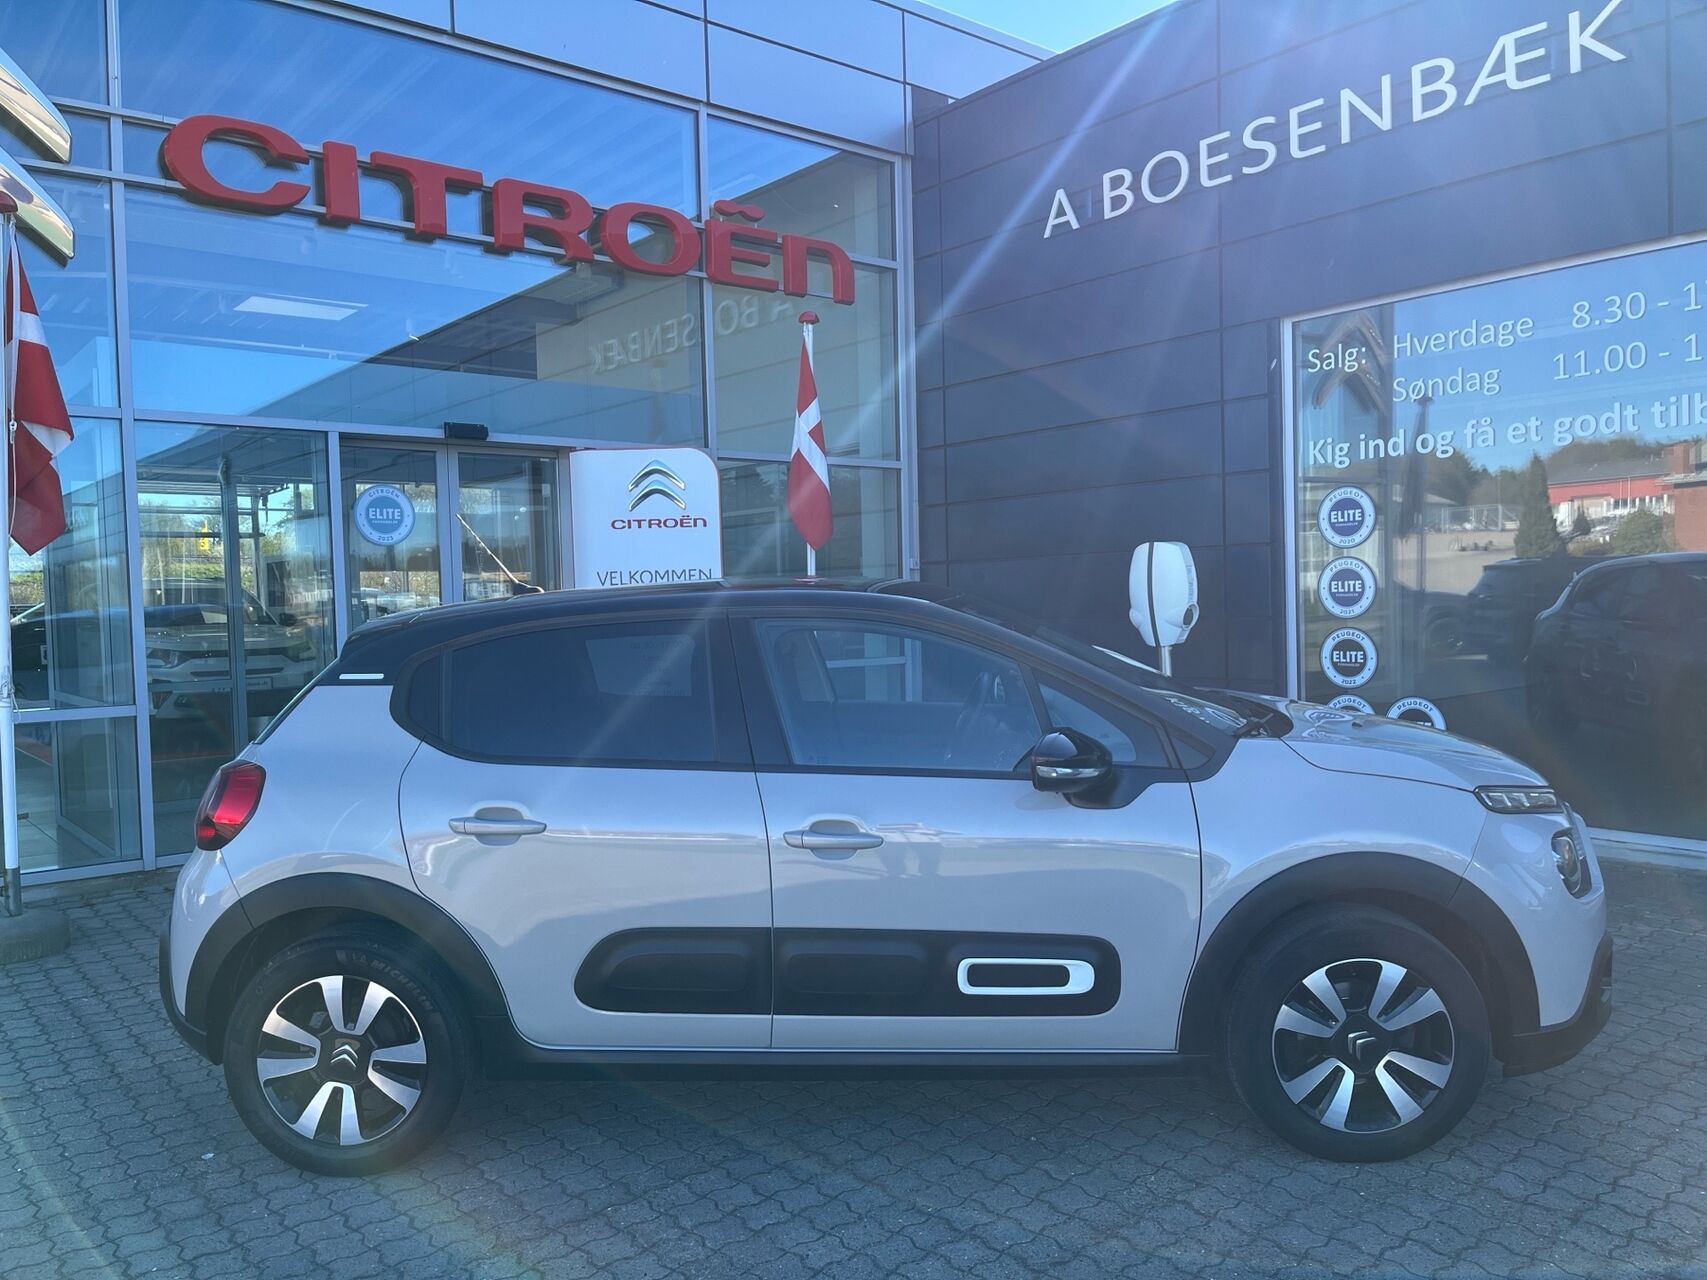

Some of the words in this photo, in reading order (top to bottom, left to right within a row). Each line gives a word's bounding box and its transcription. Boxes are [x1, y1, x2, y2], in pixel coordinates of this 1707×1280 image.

[1043, 188, 1080, 239] A
[1102, 0, 1627, 220] BOESENBÆK
[1307, 344, 1367, 374] Salg:
[1393, 316, 1535, 358] Hverdage
[1572, 291, 1646, 329] 8.30
[1683, 281, 1707, 312] 1
[1393, 367, 1502, 403] Søndag
[1553, 342, 1647, 381] 11.00
[1309, 433, 1351, 469] Kig
[1359, 429, 1406, 461] ind
[1415, 429, 1455, 459] og
[1464, 417, 1496, 449] få
[1507, 416, 1542, 444] et
[1553, 402, 1639, 446] godt
[1329, 490, 1364, 502] PEUGEOT
[368, 507, 401, 520] ELITE
[1330, 509, 1362, 523] ELITE
[1330, 560, 1364, 572] PEUGEOT
[597, 568, 713, 587] VELKOMMEN
[1331, 580, 1363, 593] ELITE
[1332, 630, 1365, 641] PEUGEOT
[1332, 650, 1364, 663] ELITE
[1332, 697, 1366, 709] PEUGEOT
[1397, 700, 1434, 712] PEUGEOT
